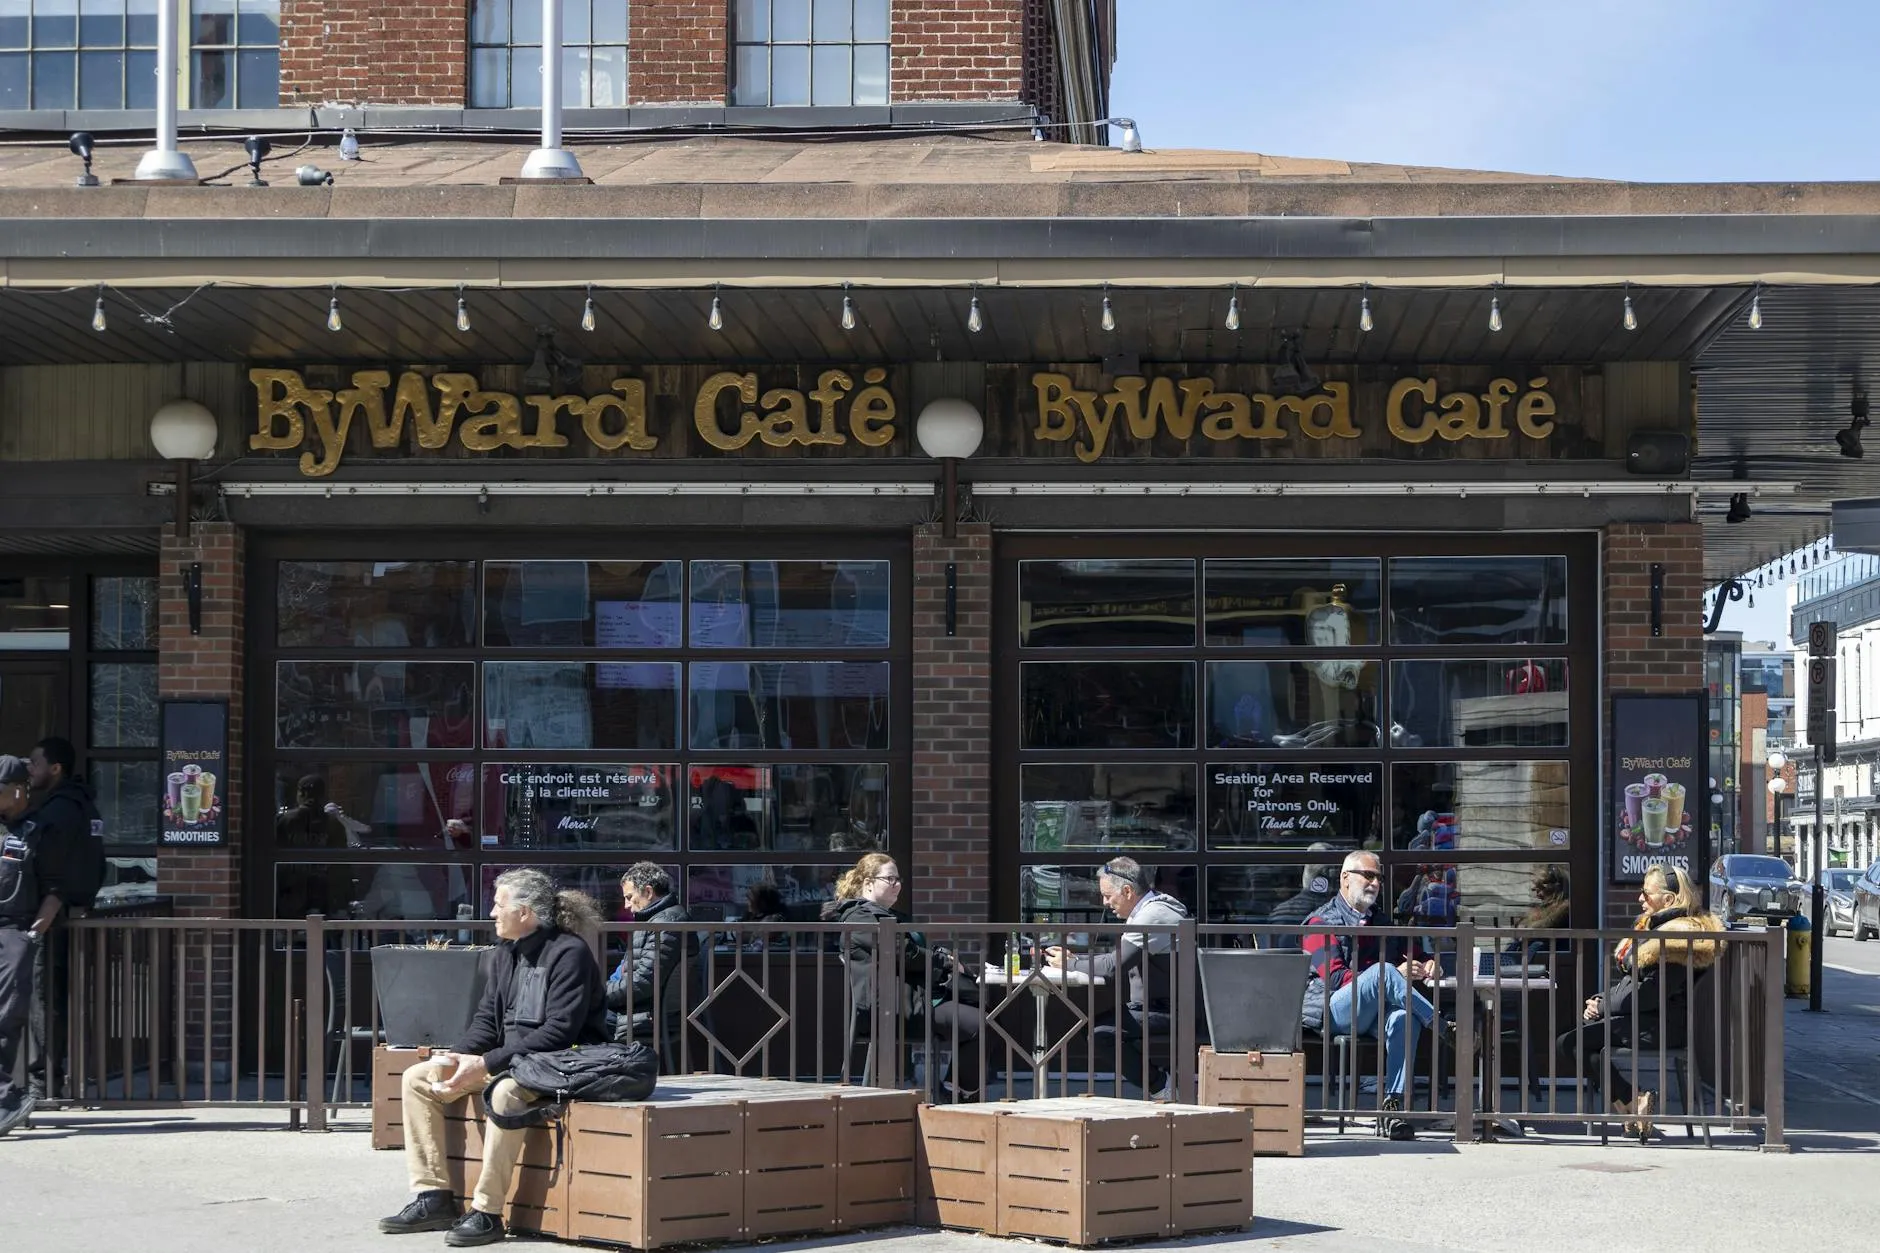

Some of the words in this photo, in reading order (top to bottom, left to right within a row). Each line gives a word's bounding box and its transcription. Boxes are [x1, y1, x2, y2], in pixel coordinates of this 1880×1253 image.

[248, 367, 659, 477] ByWard
[694, 367, 897, 451] Café
[1031, 371, 1362, 463] ByWard
[1386, 375, 1558, 444] Café
[166, 750, 199, 761] ByWard
[200, 750, 221, 760] Café
[1621, 757, 1664, 771] ByWard
[1666, 756, 1692, 769] Café
[500, 773, 522, 784] Cet
[527, 773, 574, 784] endroit
[579, 773, 600, 784] est
[606, 772, 657, 784] réservé
[1214, 773, 1266, 786] Seating
[1272, 772, 1304, 784] Area
[1309, 772, 1373, 784] Reserved
[540, 786, 551, 798] la
[557, 786, 609, 798] clientèle
[1252, 787, 1274, 798] for
[1247, 800, 1302, 812] Patrons
[1307, 800, 1340, 813] Only.
[1260, 815, 1294, 829] Thank
[1298, 815, 1327, 829] You!
[164, 831, 220, 842] SMOOTHIES
